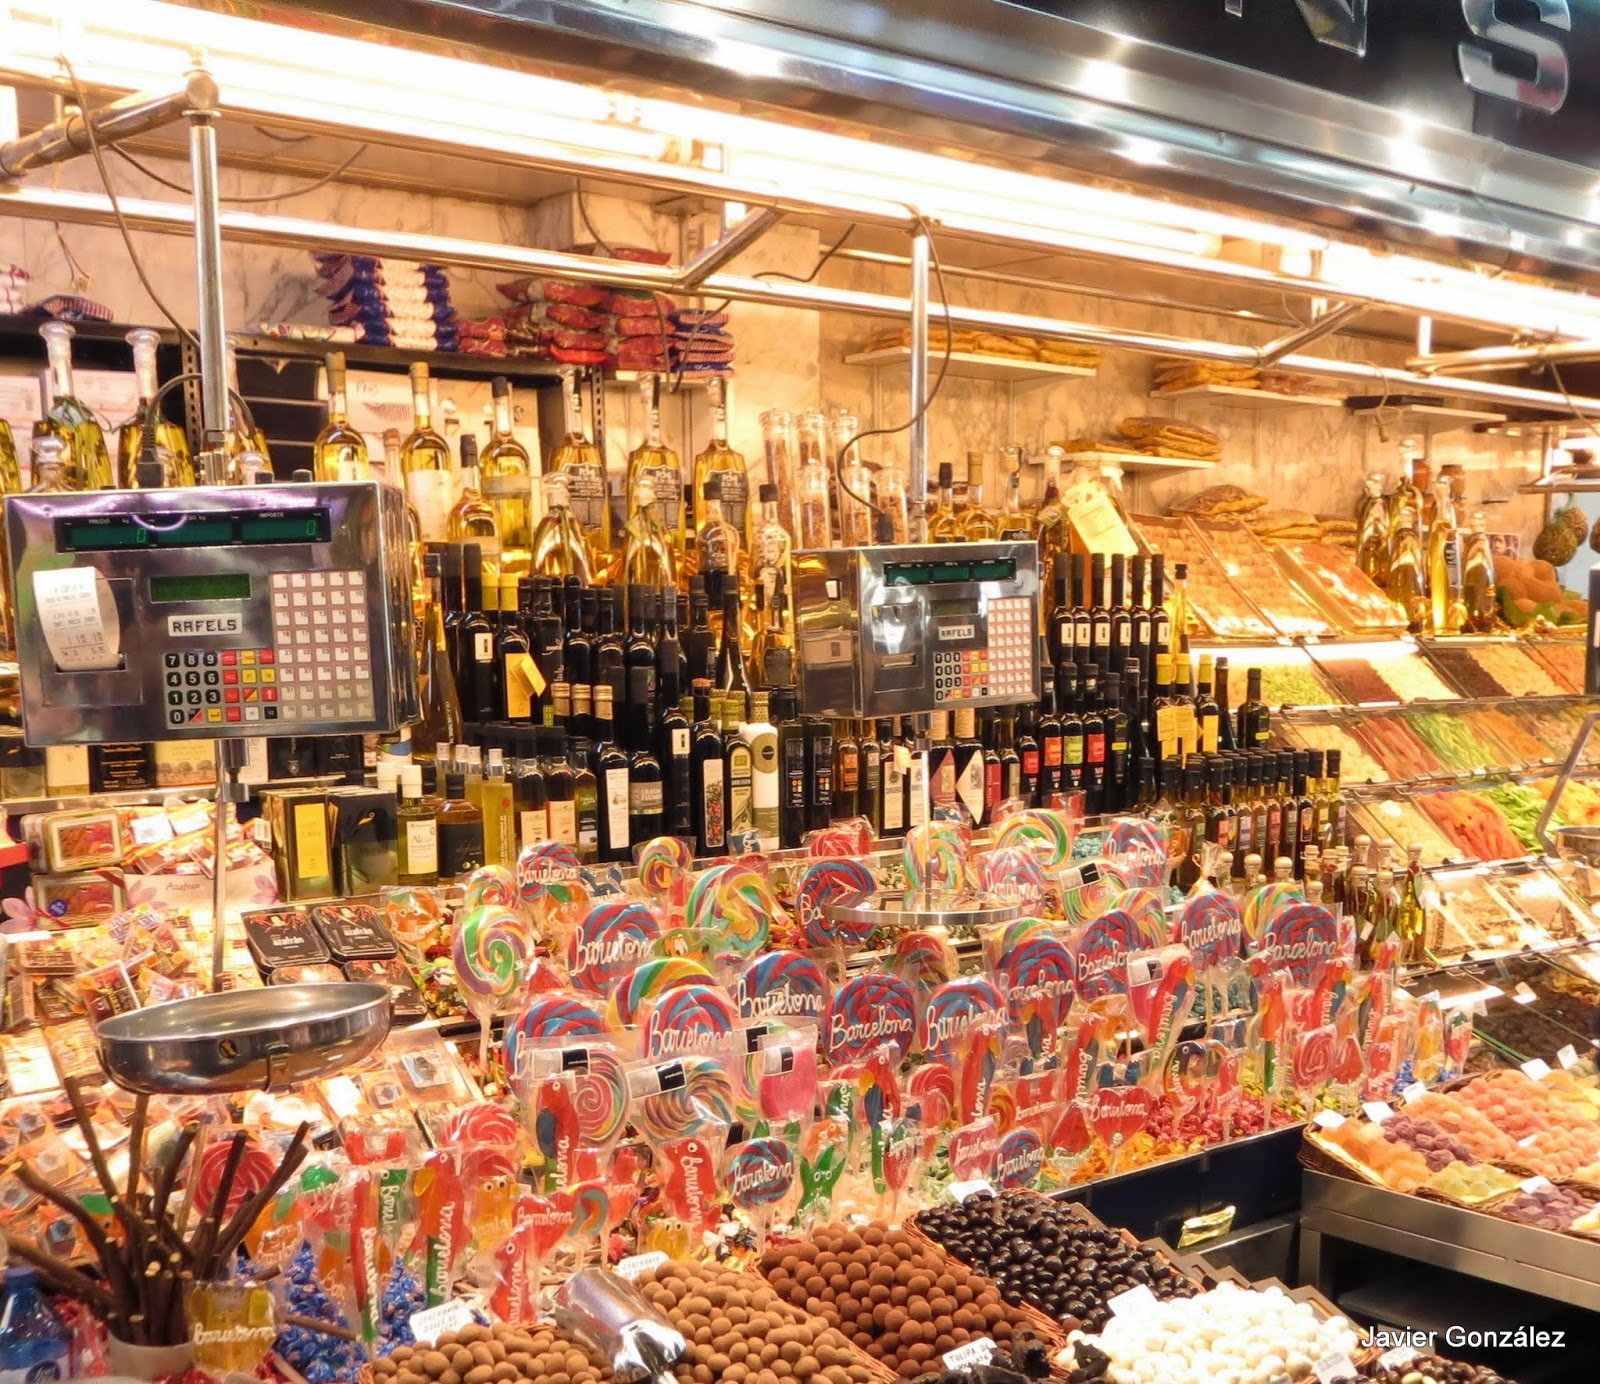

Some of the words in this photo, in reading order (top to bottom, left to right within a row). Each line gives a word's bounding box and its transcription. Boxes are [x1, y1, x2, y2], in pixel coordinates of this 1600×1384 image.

[173, 619, 238, 633] RAFELS
[169, 655, 176, 665] 7
[188, 655, 195, 665] 8
[206, 654, 214, 664] 9
[171, 675, 178, 684] 4
[189, 674, 197, 683] 5
[208, 673, 215, 683] 6
[173, 694, 178, 703] 1
[191, 693, 198, 702] 2
[209, 692, 217, 701] 3
[174, 712, 180, 721] 0
[516, 862, 578, 888] Barcelona
[1181, 916, 1243, 950] Barcelona
[1264, 928, 1337, 961] Barcelona
[738, 979, 826, 1018] Barcelona
[830, 1006, 915, 1053] Barcelona
[731, 1159, 795, 1200] Barcelona
[429, 1201, 456, 1296] Barcelona
[949, 1347, 976, 1363] TULIPA
